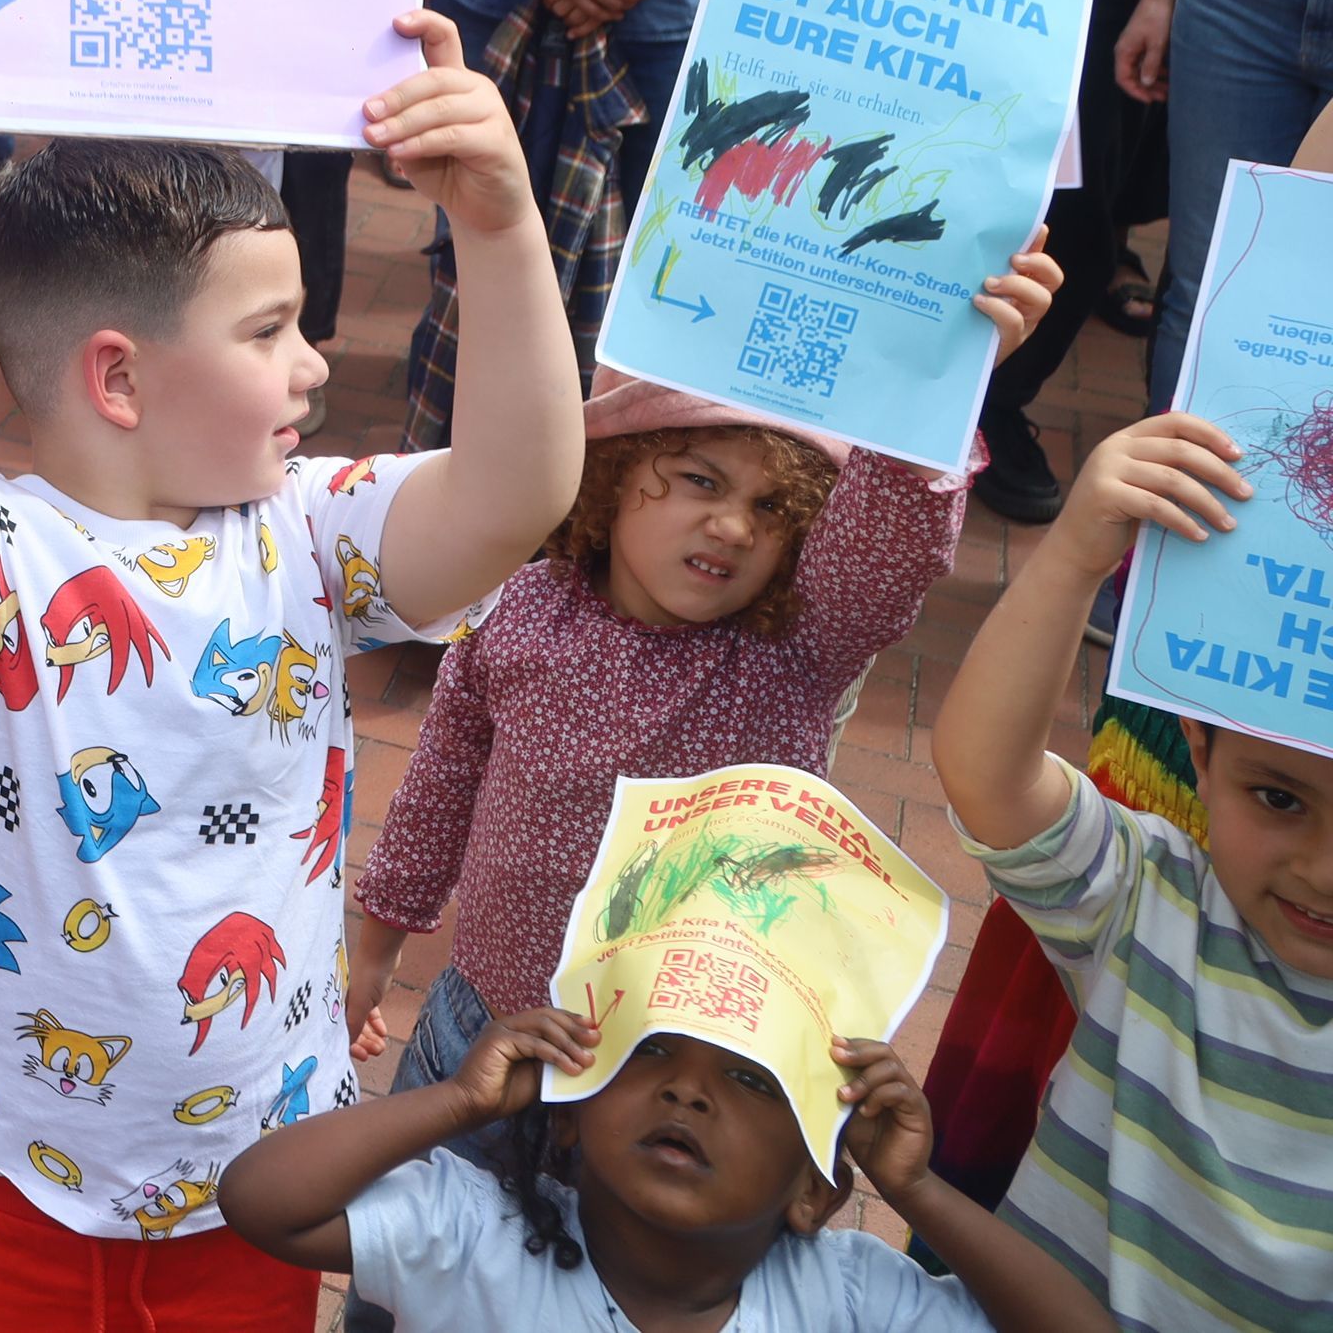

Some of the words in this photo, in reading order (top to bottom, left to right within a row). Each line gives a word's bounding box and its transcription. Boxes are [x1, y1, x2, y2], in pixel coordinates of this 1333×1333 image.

[724, 52, 767, 80] Helft
[771, 68, 802, 92] mit,
[807, 79, 830, 97] sie
[834, 89, 851, 104] zu
[857, 92, 925, 126] erhalten.
[735, 3, 862, 64] EURE
[864, 39, 982, 101] KITA.
[1246, 553, 1332, 608] TA.
[1164, 630, 1293, 699] KITA
[644, 795, 759, 833] UNSER
[771, 796, 909, 902] VEEDEL.
[649, 779, 791, 815] UNSERE
[798, 790, 881, 862] KITA.
